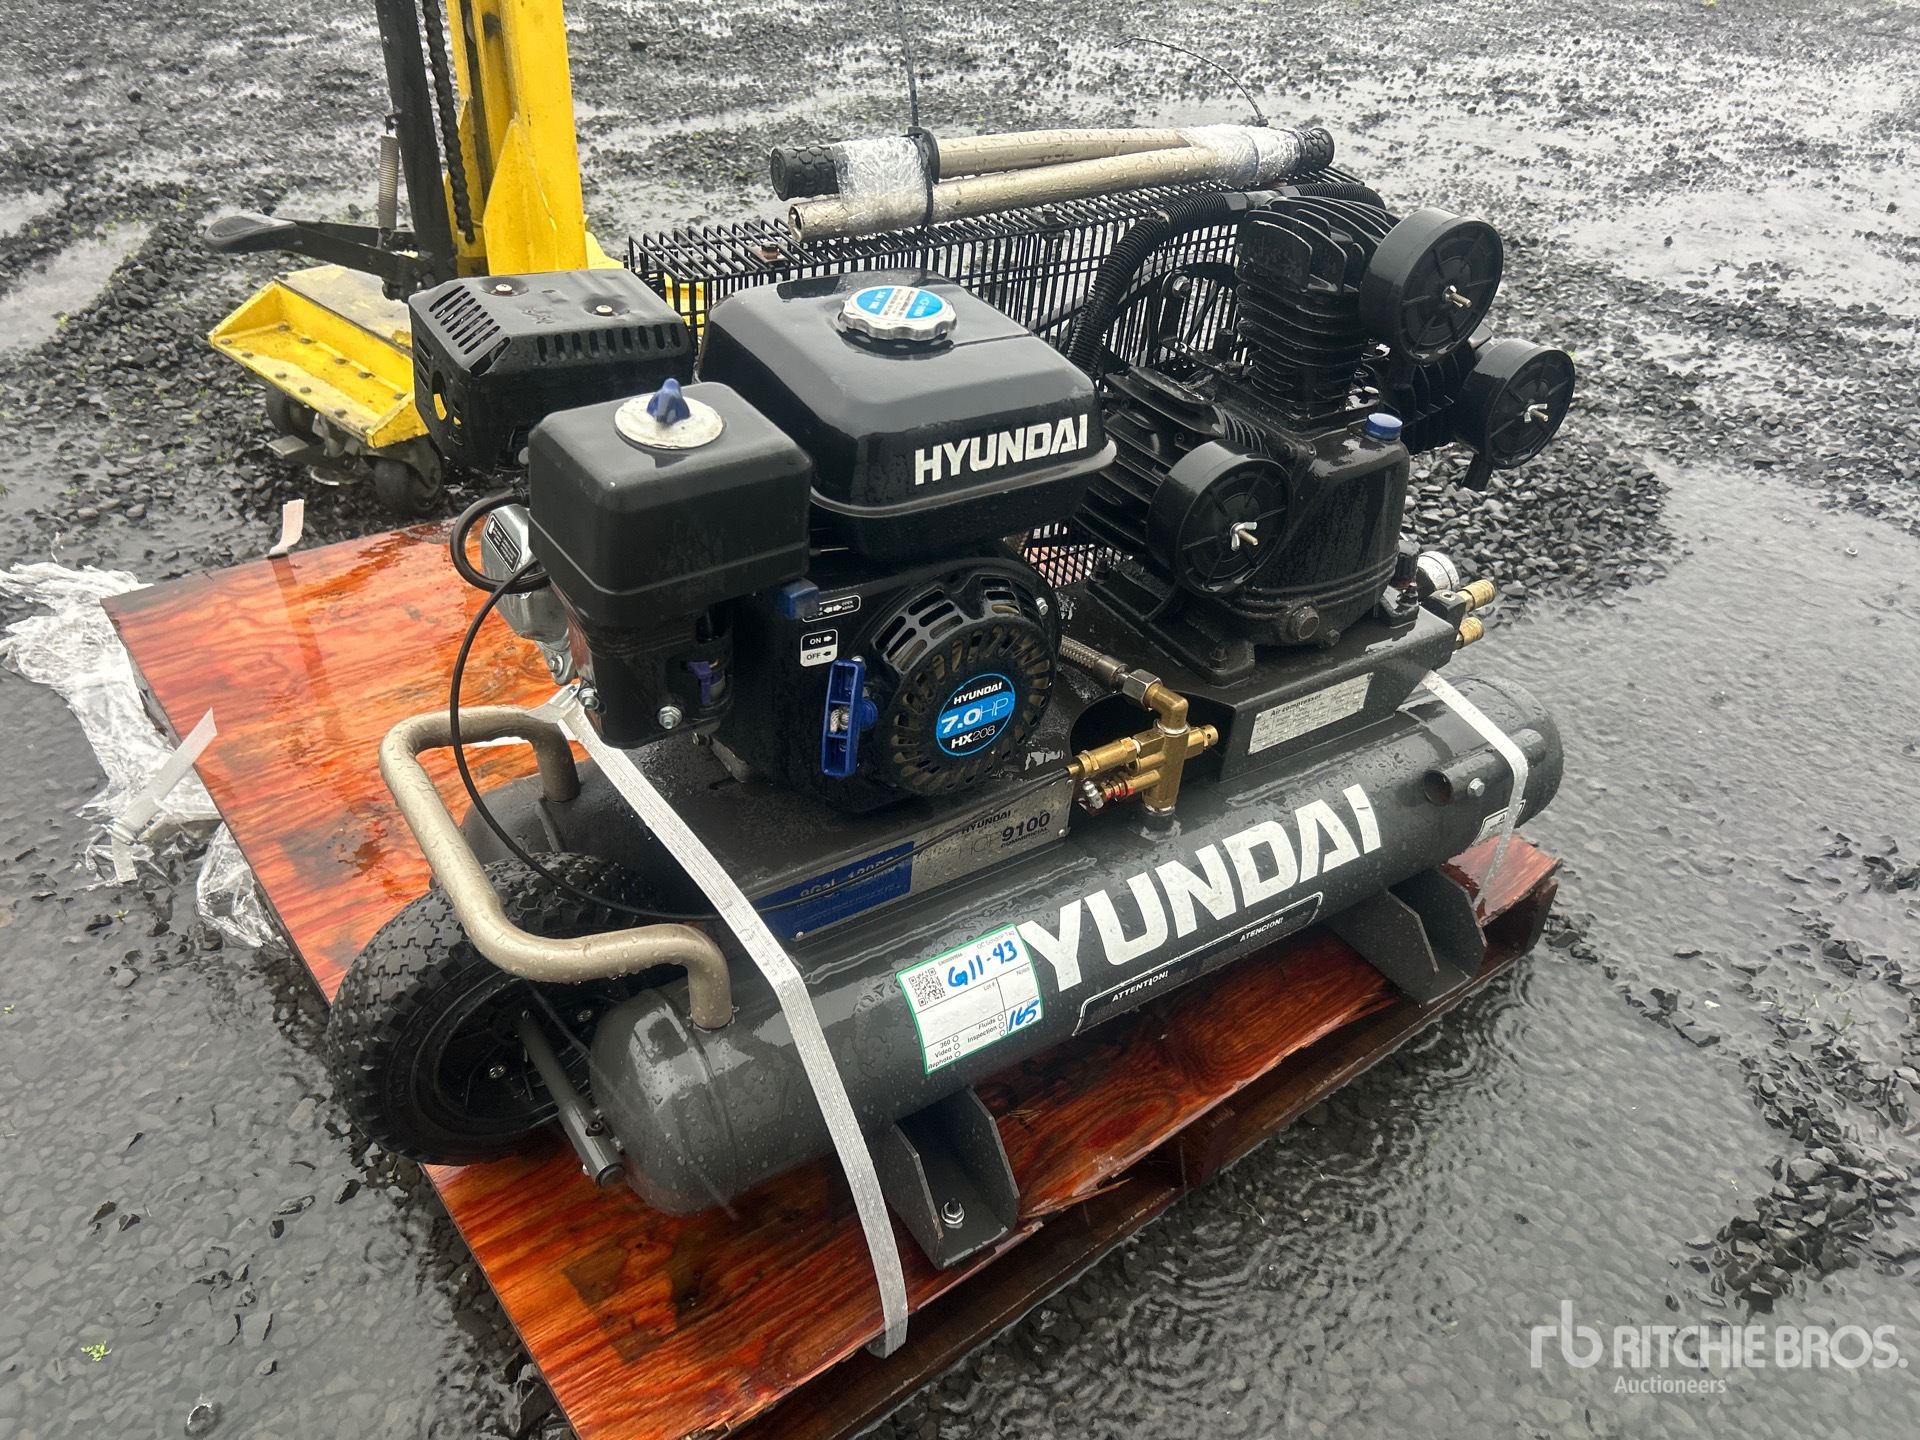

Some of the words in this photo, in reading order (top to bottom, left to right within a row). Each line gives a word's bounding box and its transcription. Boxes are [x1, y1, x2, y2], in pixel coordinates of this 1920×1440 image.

[915, 414, 1088, 486] HYUNDAI
[809, 637, 822, 645] ON
[806, 652, 821, 661] OFF
[953, 682, 1003, 705] HYUNDAI
[951, 724, 996, 749] HX208
[961, 810, 1011, 835] HYUNDAI
[1020, 783, 1382, 992] YUNDAI
[1239, 916, 1284, 943] ATENCION!
[1016, 966, 1030, 976] Notes
[983, 983, 991, 991] Lot
[1112, 970, 1169, 1001] ATTENTION!
[978, 1017, 996, 1030] Fluids
[1008, 999, 1039, 1032] 165
[967, 1025, 998, 1043] Inspection
[934, 1047, 952, 1058] Video
[940, 1039, 951, 1049] 360
[928, 1055, 953, 1070] Rephoto
